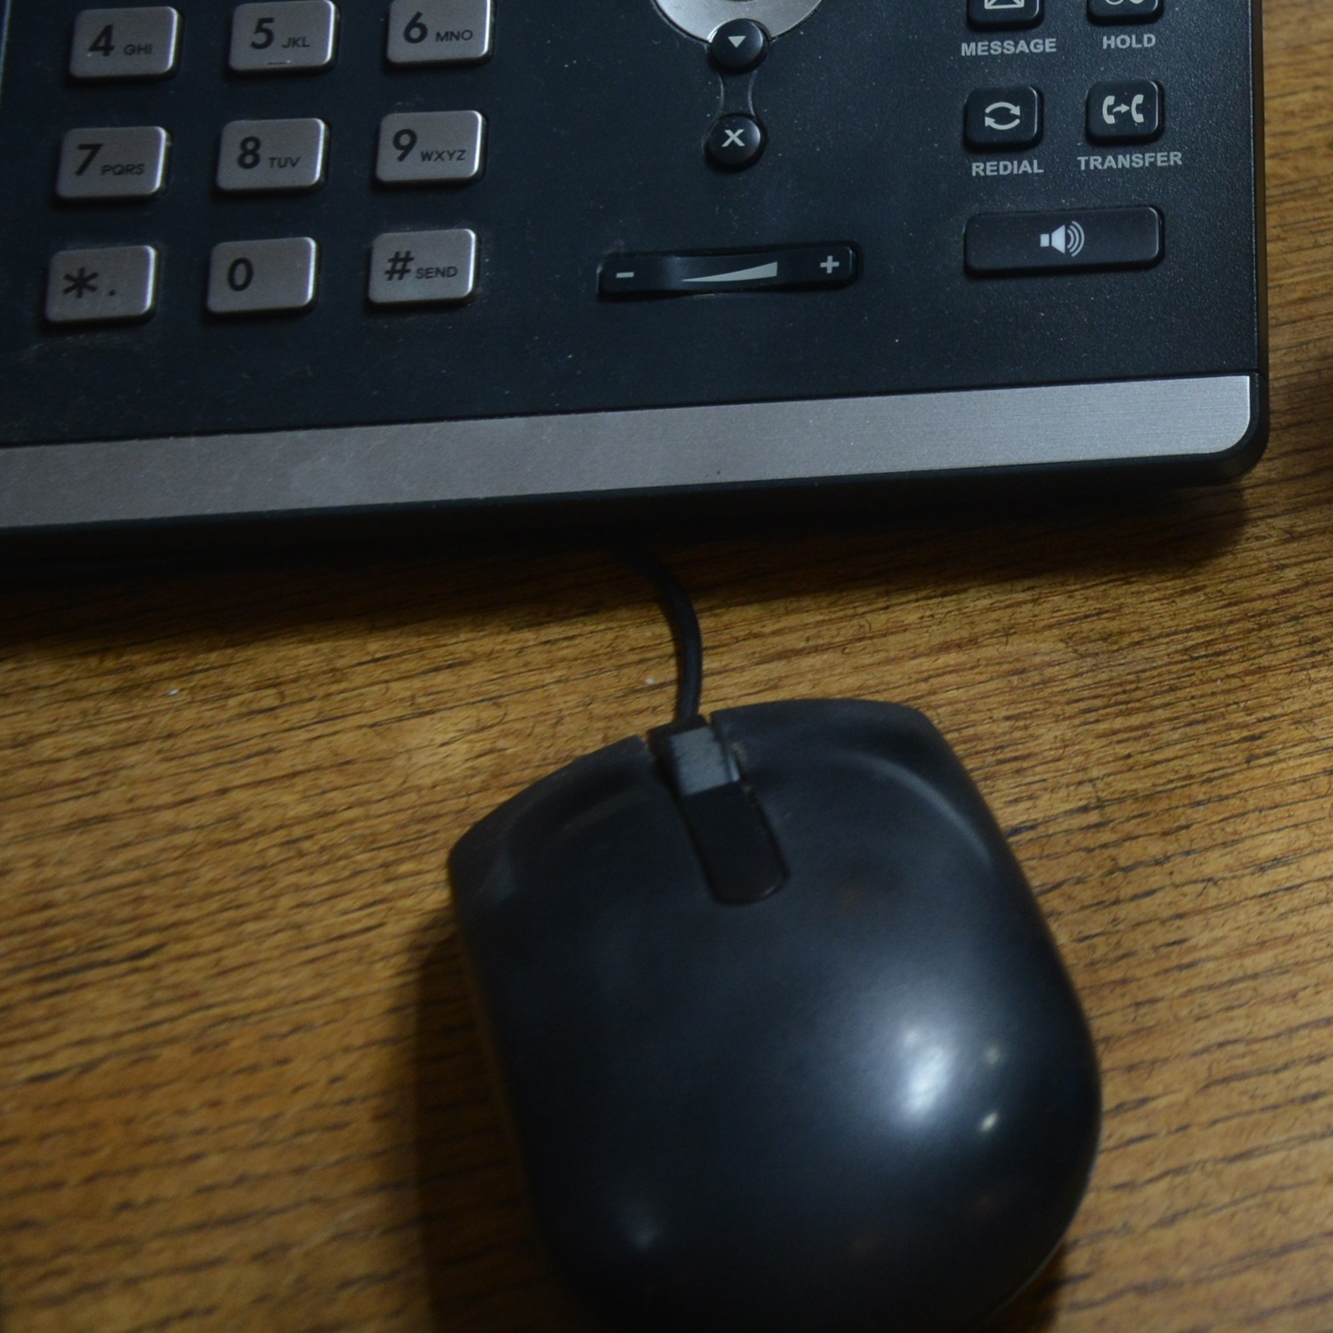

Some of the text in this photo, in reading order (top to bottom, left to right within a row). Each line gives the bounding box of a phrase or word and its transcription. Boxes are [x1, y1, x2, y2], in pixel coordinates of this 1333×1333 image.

[88, 25, 153, 57] 4 GHI
[249, 18, 311, 50] 5 JKL
[403, 12, 473, 44] 6 MNO
[1102, 32, 1156, 49] HOLD
[961, 37, 1057, 55] MESSAGE
[76, 143, 145, 177] 7 PQRS
[236, 137, 301, 170] 8 TUV
[392, 129, 467, 163] 9 WXYZ
[1077, 152, 1183, 171] TRANSFER
[971, 159, 1044, 176] REDIAL
[227, 258, 253, 292] 0
[415, 264, 457, 280] SEND
